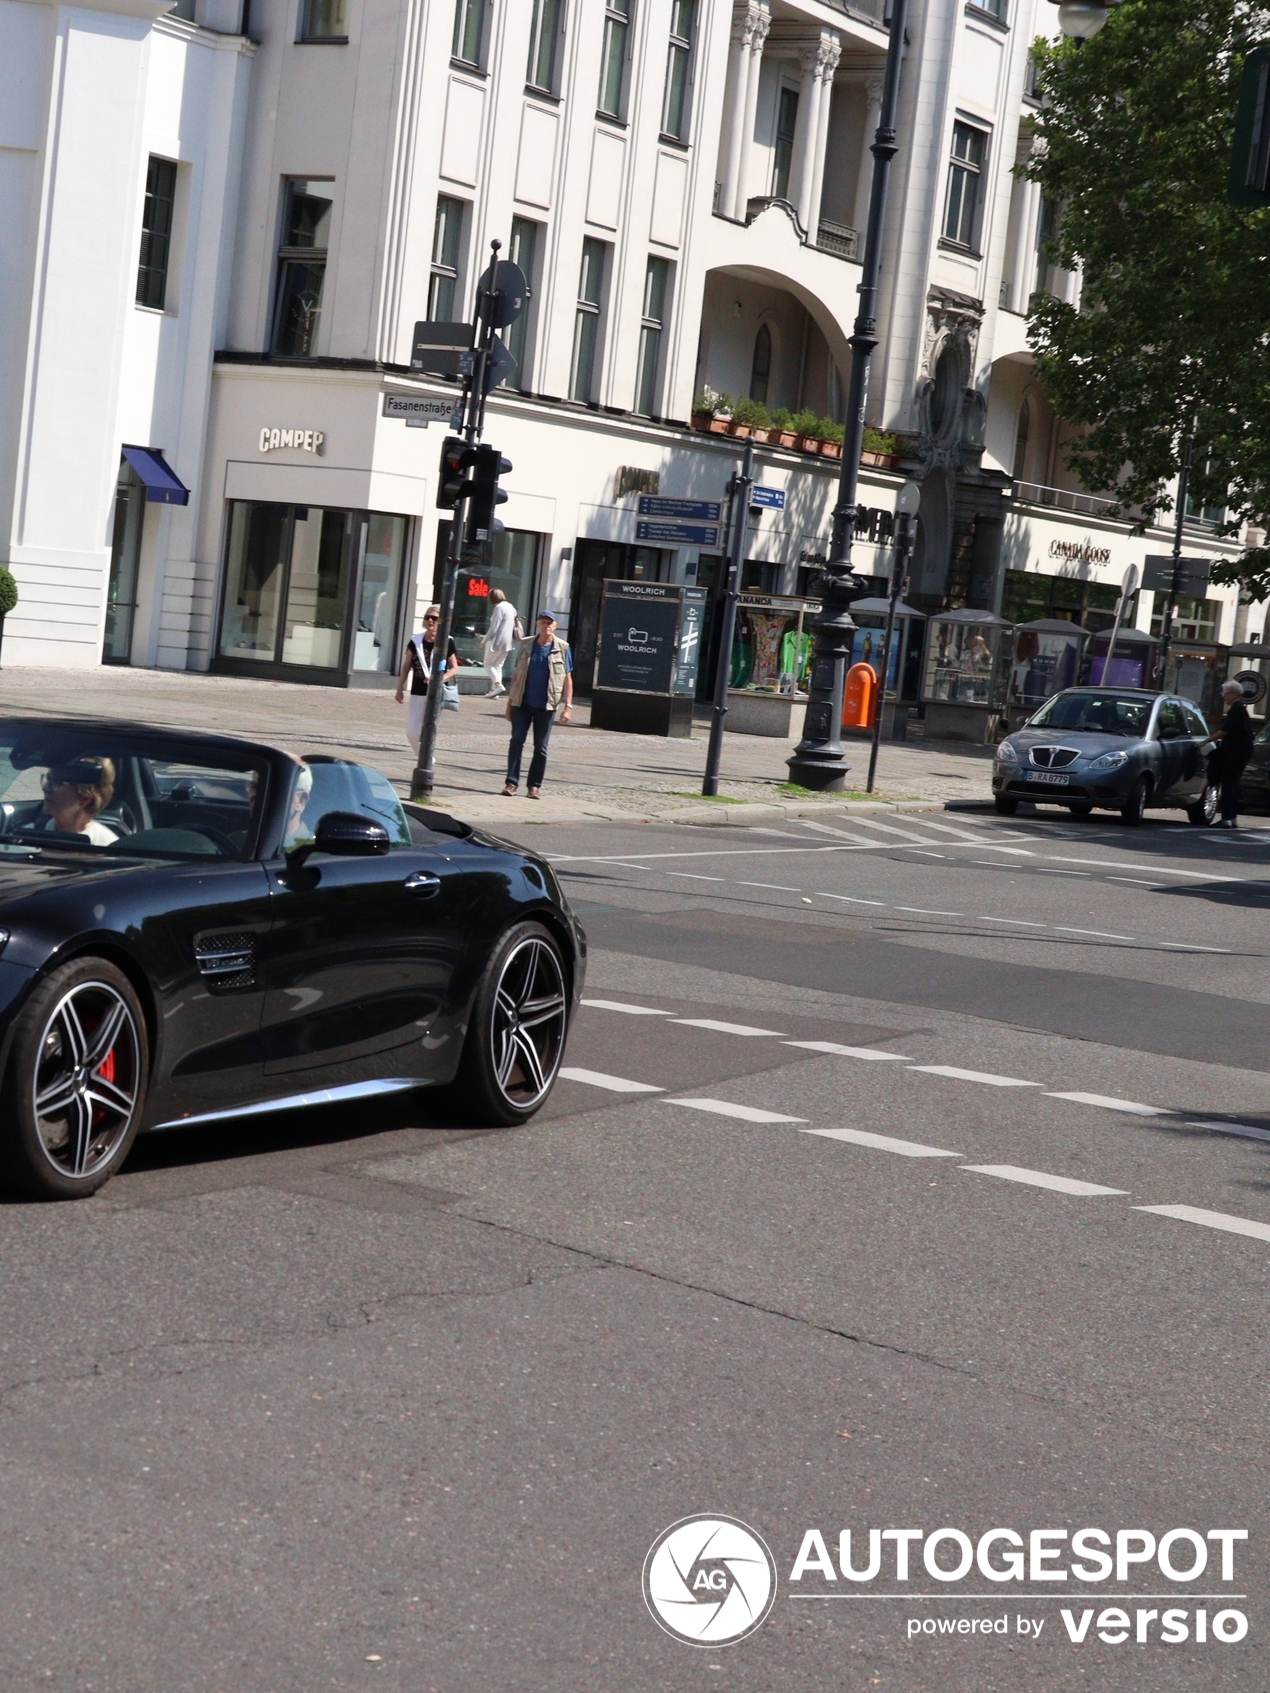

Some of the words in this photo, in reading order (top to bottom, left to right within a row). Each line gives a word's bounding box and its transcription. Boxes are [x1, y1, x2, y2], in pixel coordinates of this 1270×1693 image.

[387, 397, 452, 416] Fasanenstraße
[259, 427, 325, 457] CAMPER
[468, 578, 489, 597] Sale
[622, 585, 665, 596] WOOLRICH
[617, 644, 657, 654] WOOLRICH
[1028, 771, 1034, 779] B
